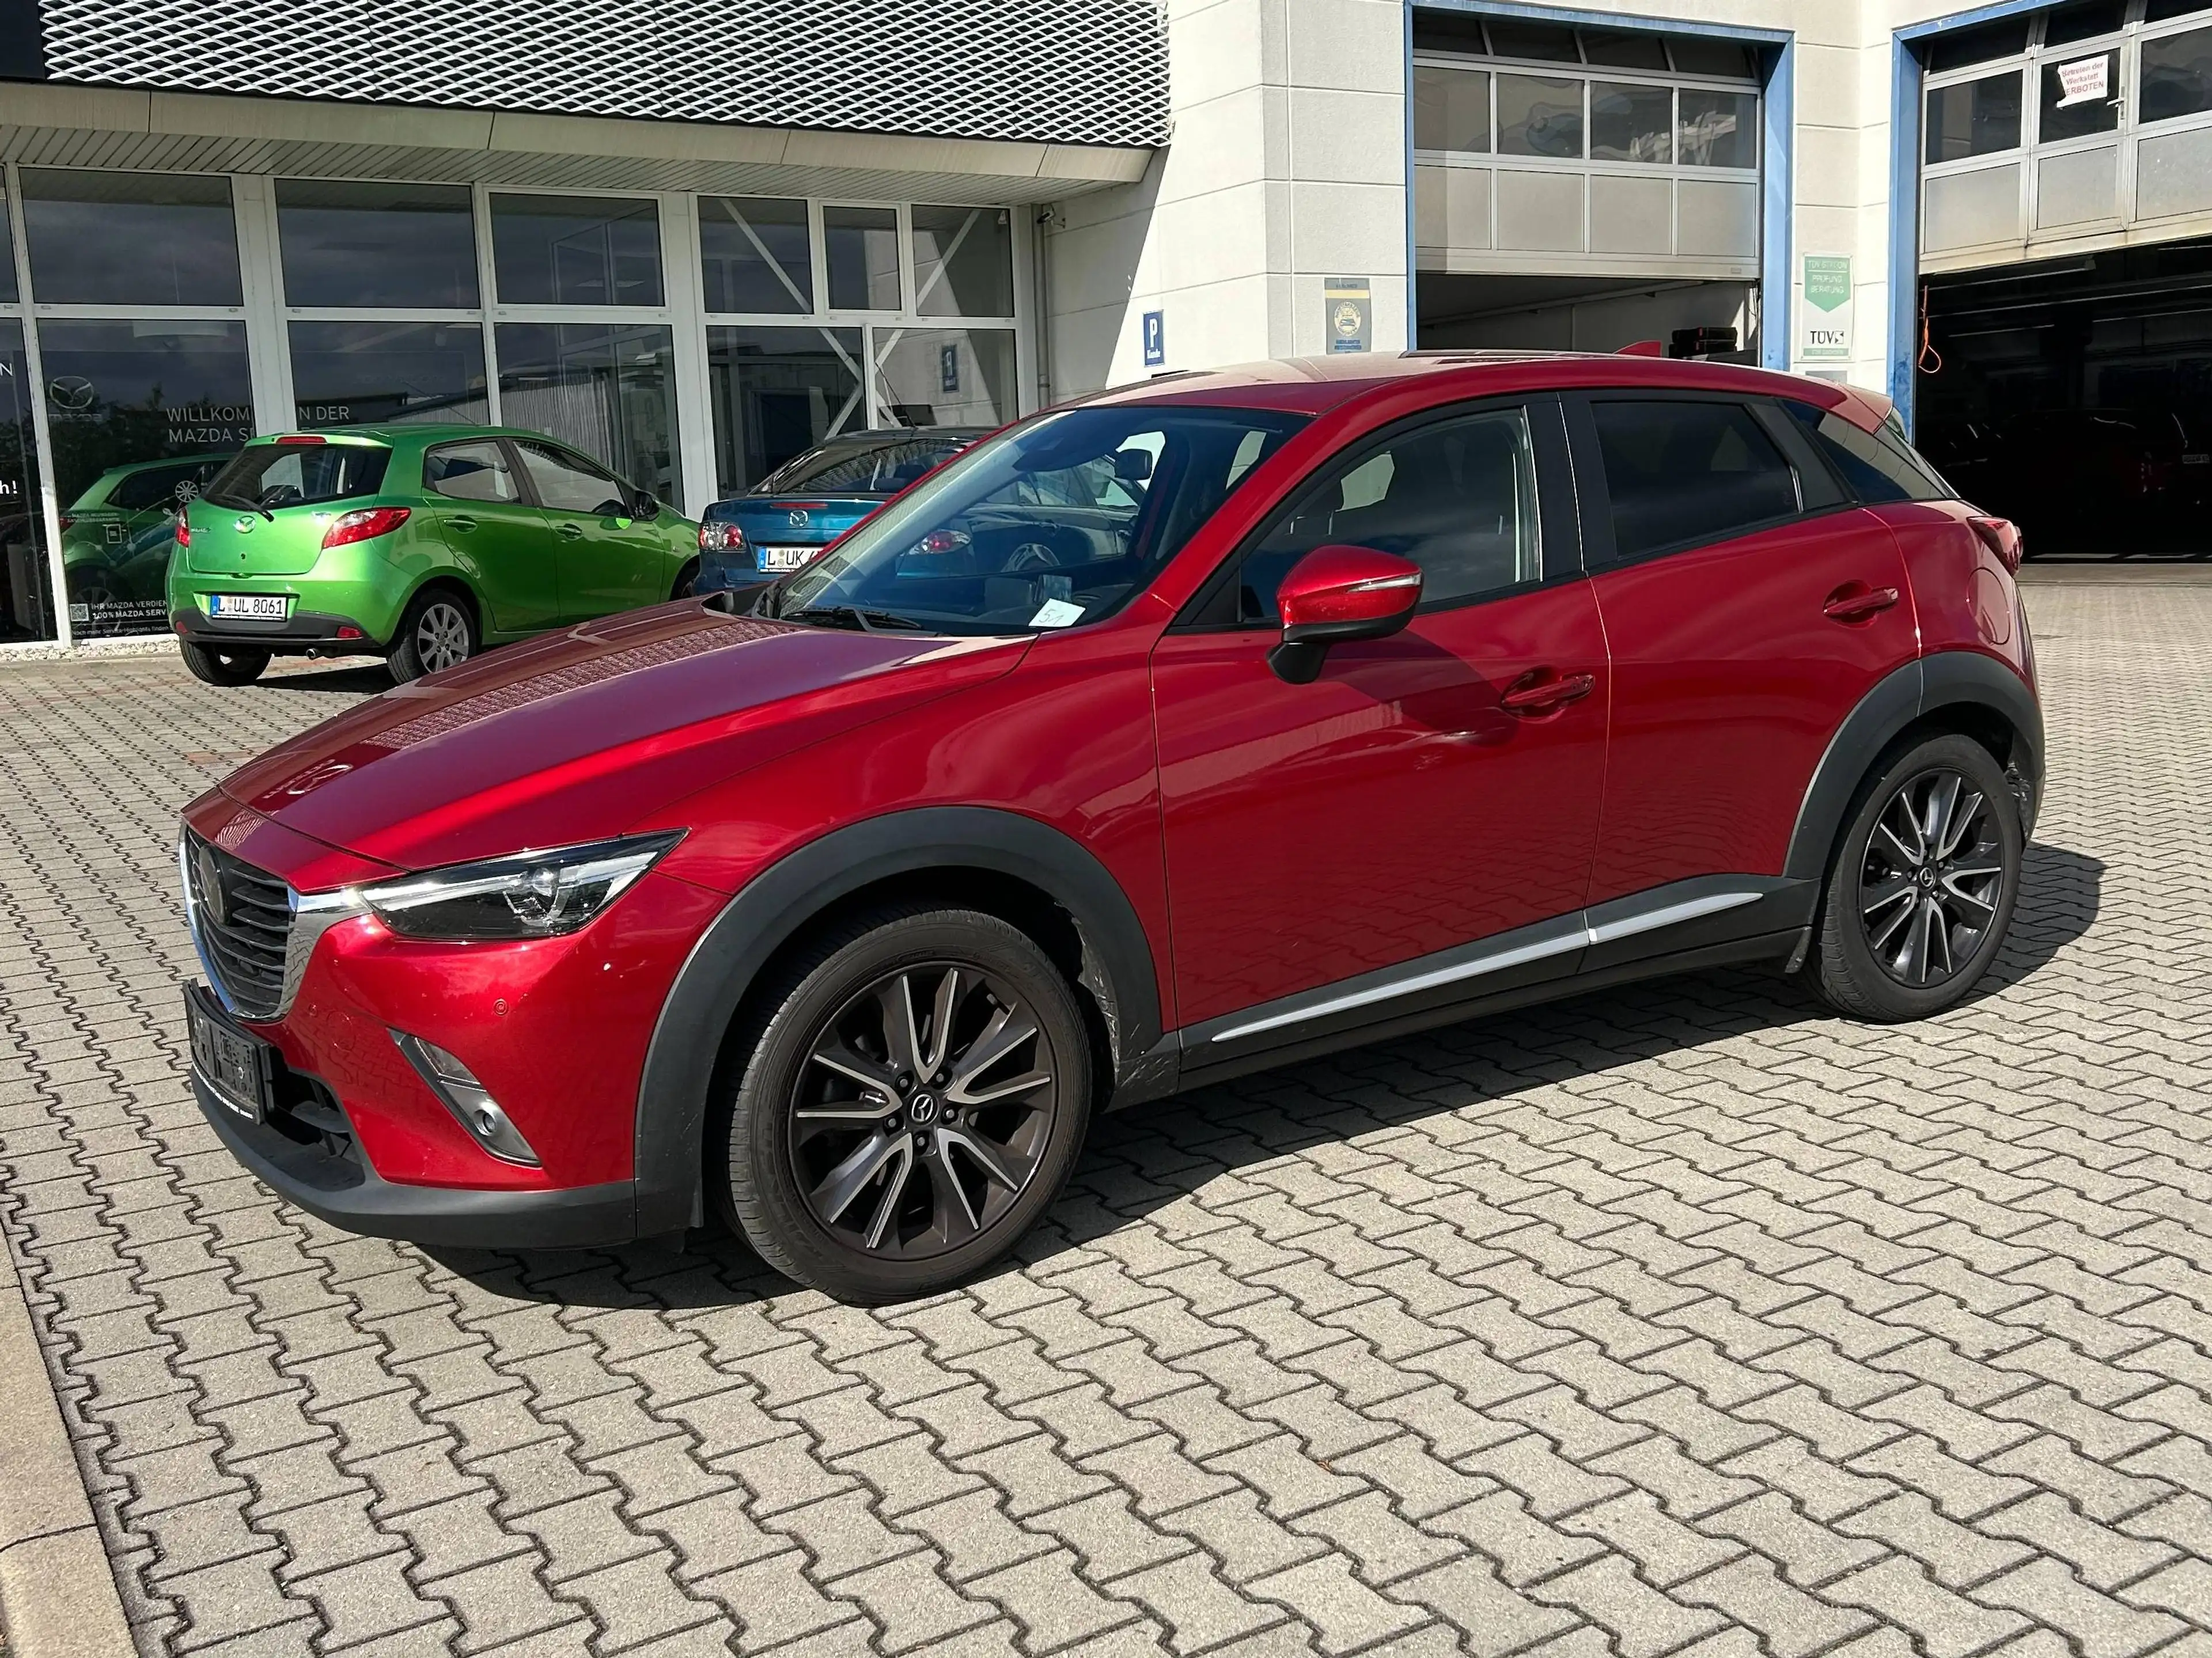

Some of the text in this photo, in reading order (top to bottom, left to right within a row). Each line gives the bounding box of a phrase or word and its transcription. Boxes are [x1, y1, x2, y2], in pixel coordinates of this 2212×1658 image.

[2065, 81, 2104, 96] ERBOTEN
[1149, 318, 1158, 348] P
[166, 406, 251, 422] WILLKOM
[317, 405, 349, 420] DER
[168, 428, 233, 443] MAZDA
[767, 551, 775, 566] L
[786, 550, 804, 566] UK
[218, 597, 282, 614] L UL 8061
[116, 610, 144, 618] MAZDA
